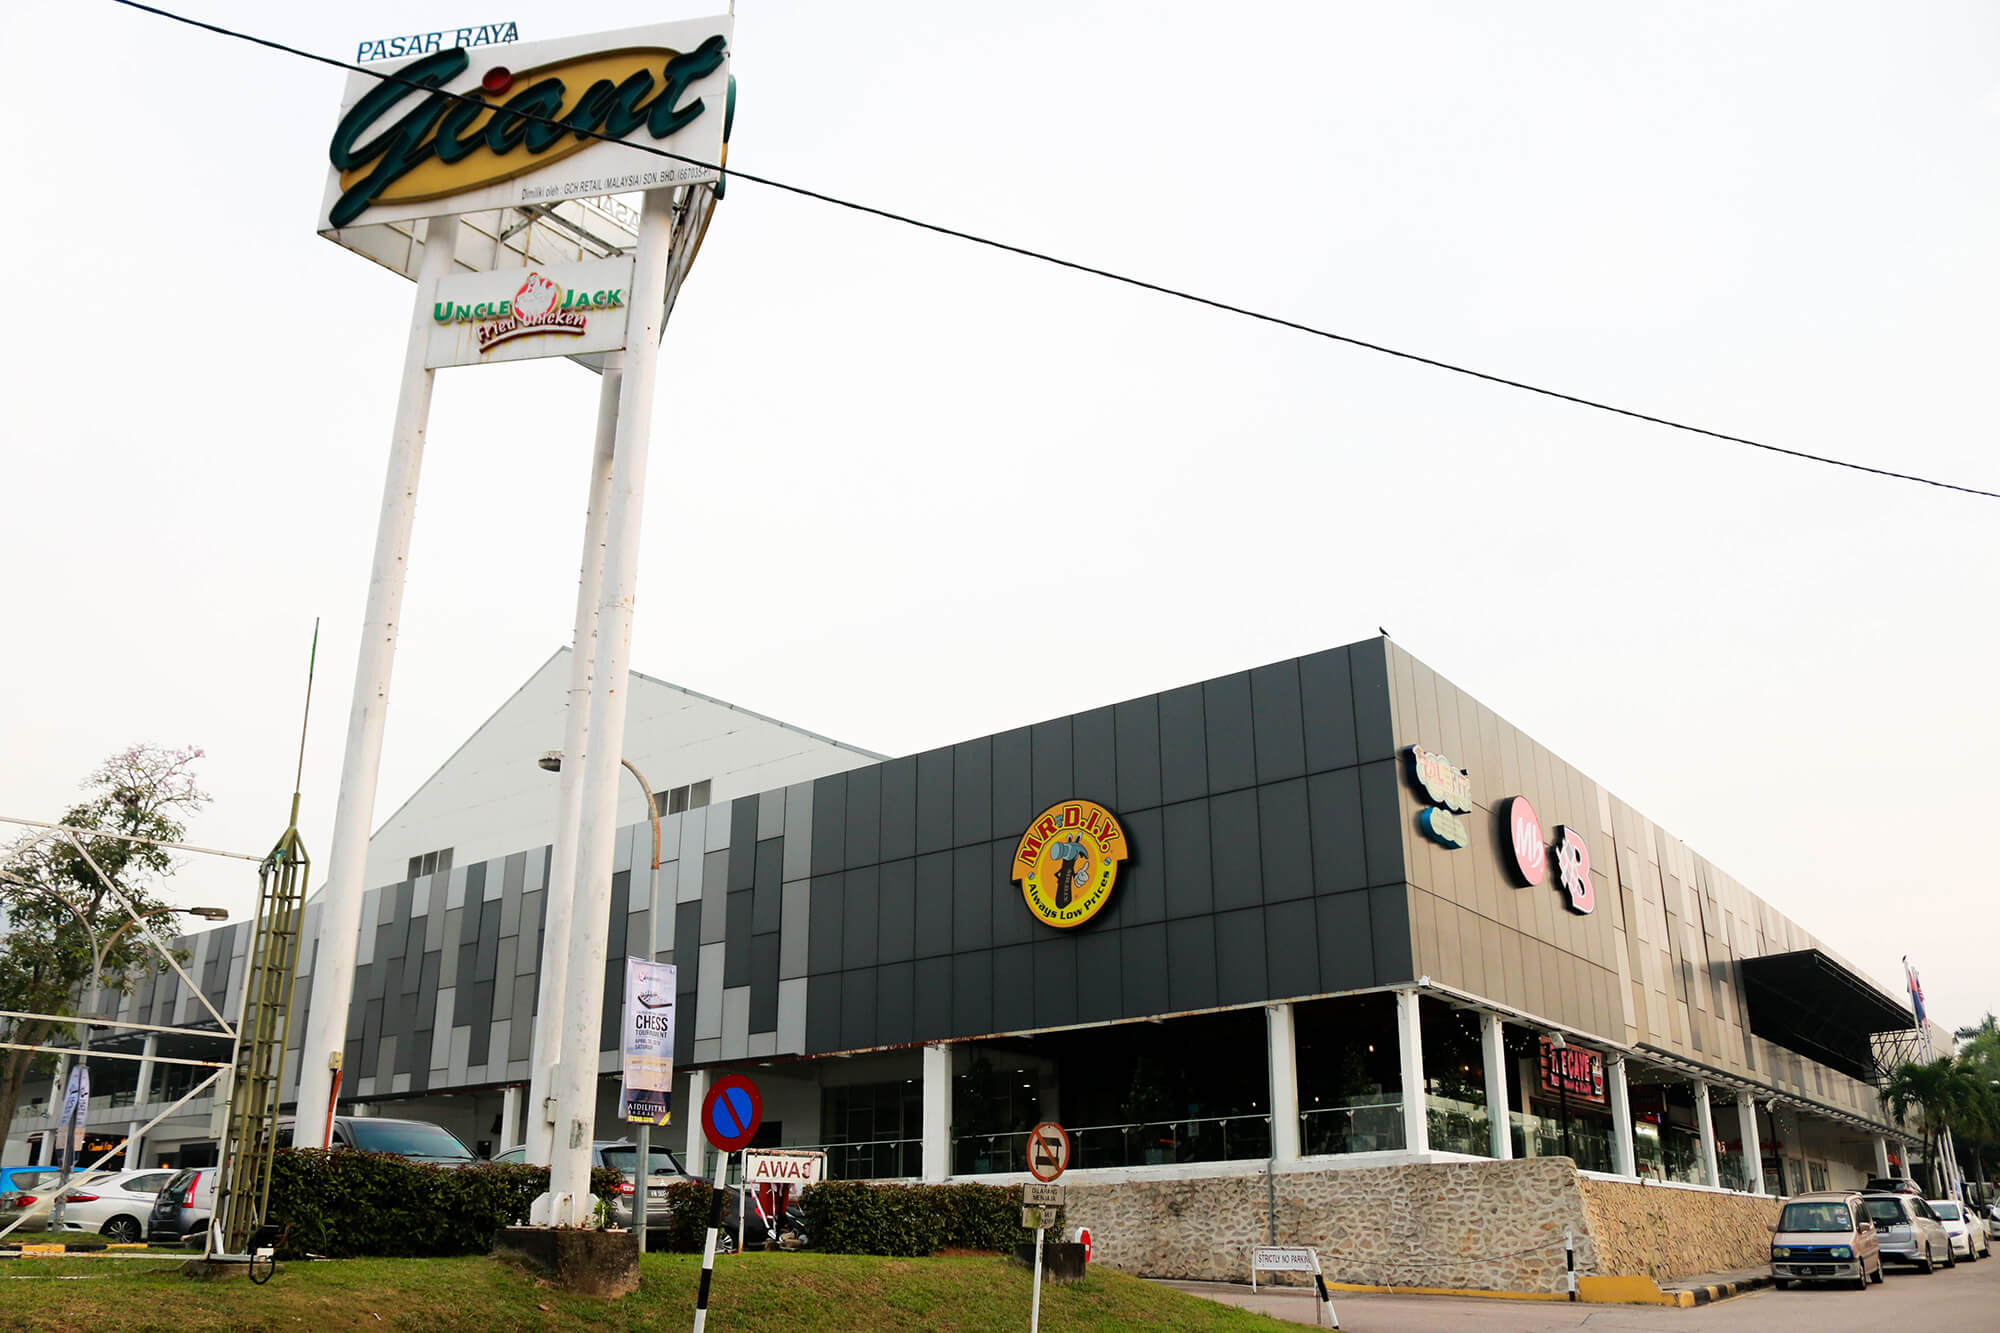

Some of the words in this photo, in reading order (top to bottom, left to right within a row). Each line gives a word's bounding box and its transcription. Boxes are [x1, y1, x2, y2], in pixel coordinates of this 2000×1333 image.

[357, 32, 442, 64] PASAR
[455, 21, 519, 48] RAYA
[328, 34, 728, 229] Giant
[579, 179, 603, 192] RETAIL
[433, 300, 512, 323] UNCLE
[560, 289, 623, 310] JACK
[476, 316, 518, 345] Fried
[1028, 883, 1058, 918] Always
[1060, 908, 1083, 920] Low
[1084, 870, 1110, 910] Prices
[635, 1014, 669, 1032] CHESS
[756, 1160, 811, 1179] AWAS
[1258, 1253, 1280, 1264] STRICTLY
[1281, 1254, 1290, 1264] NO
